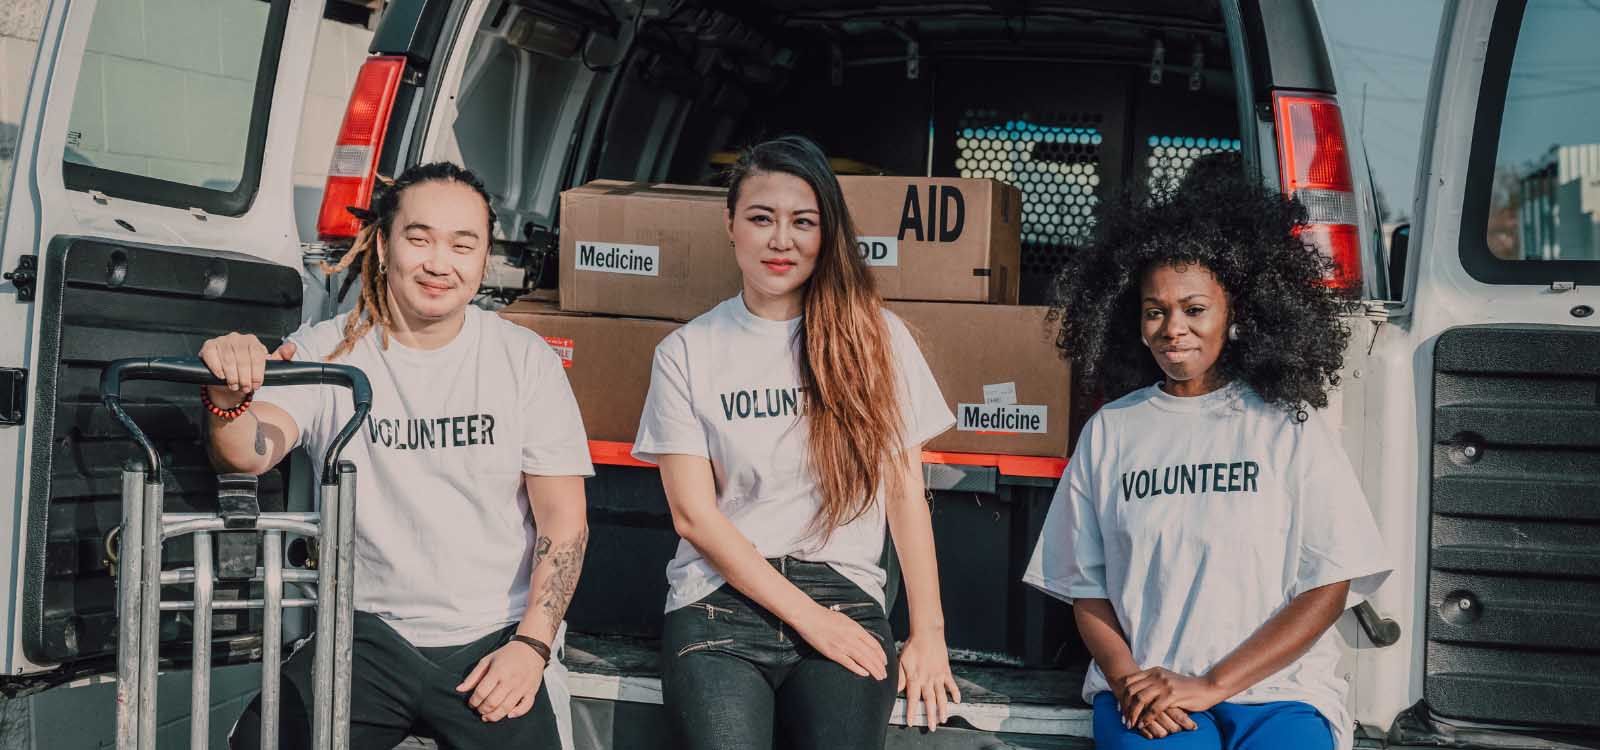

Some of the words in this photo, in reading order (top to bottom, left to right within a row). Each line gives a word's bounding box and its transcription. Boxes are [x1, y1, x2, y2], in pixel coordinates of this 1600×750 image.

[897, 185, 965, 242] AID
[580, 245, 653, 272] Medicine
[368, 414, 495, 450] VOLUNTEER
[964, 406, 1040, 430] Medicine
[1122, 461, 1259, 501] VOLUNTEER
